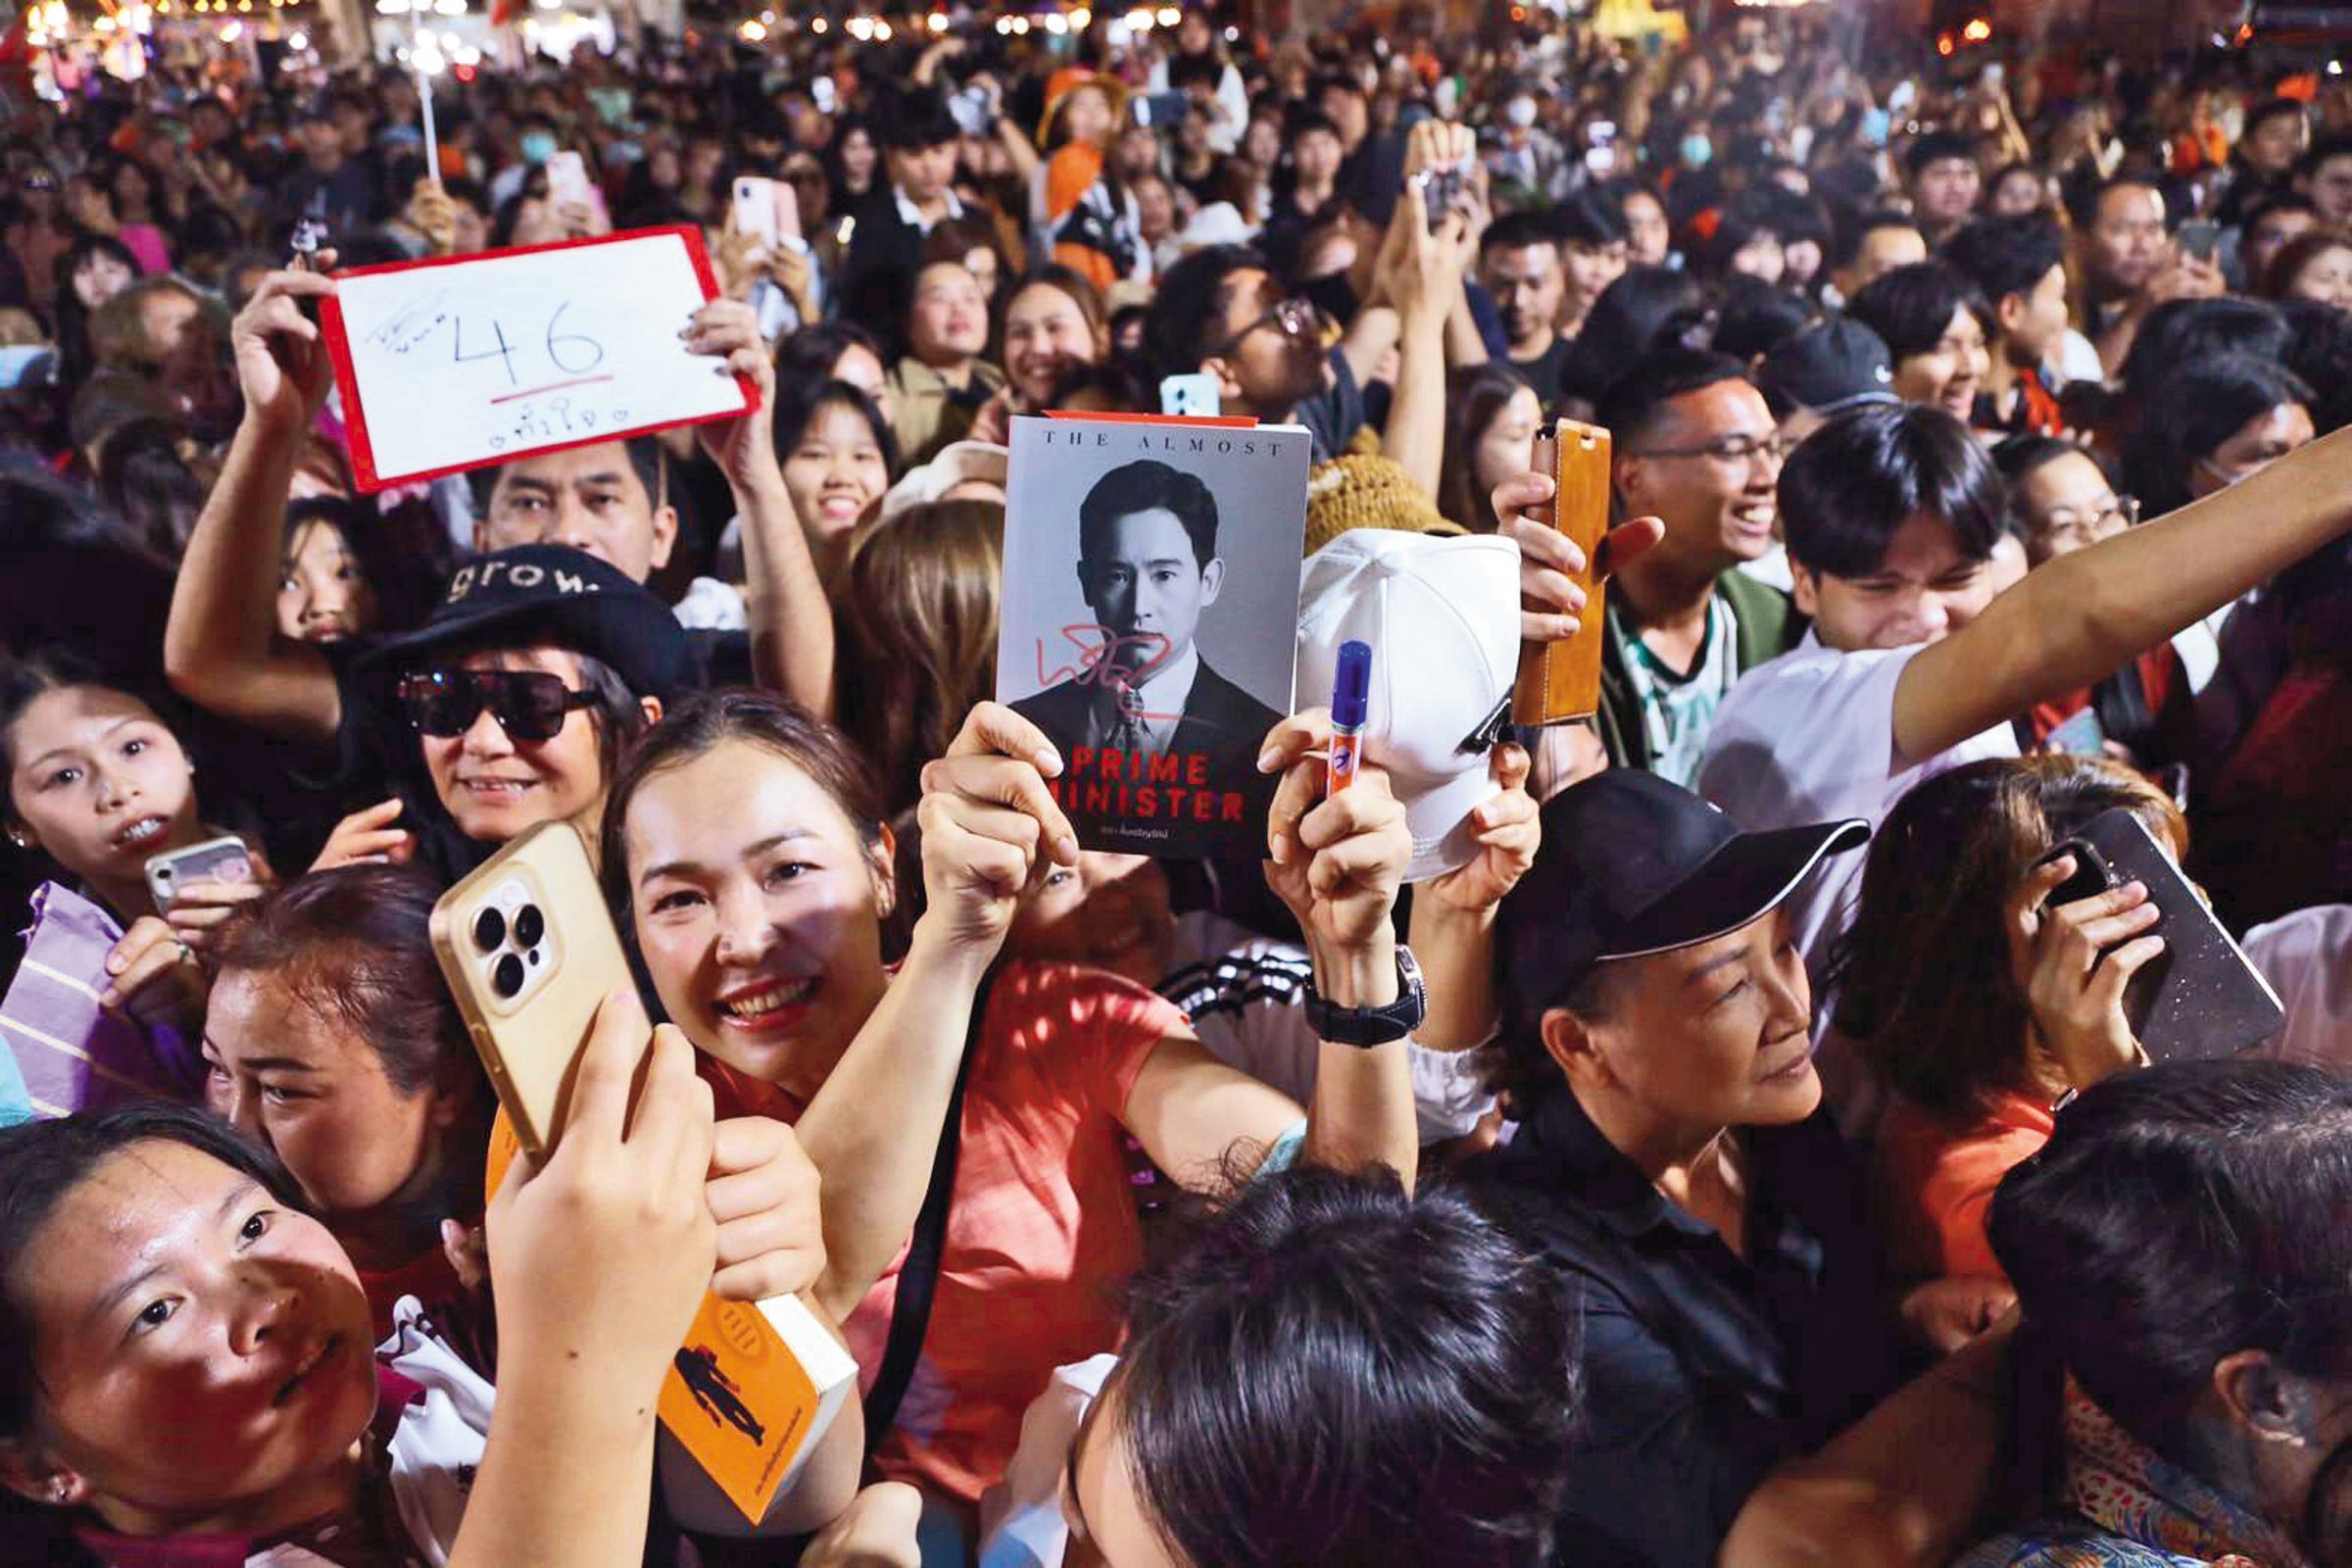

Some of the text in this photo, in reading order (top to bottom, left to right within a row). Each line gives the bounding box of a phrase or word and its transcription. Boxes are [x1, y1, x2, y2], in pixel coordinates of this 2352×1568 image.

[454, 300, 604, 385] 46
[1045, 430, 1282, 458] THE ALMOST
[1072, 745, 1208, 786] PRIME
